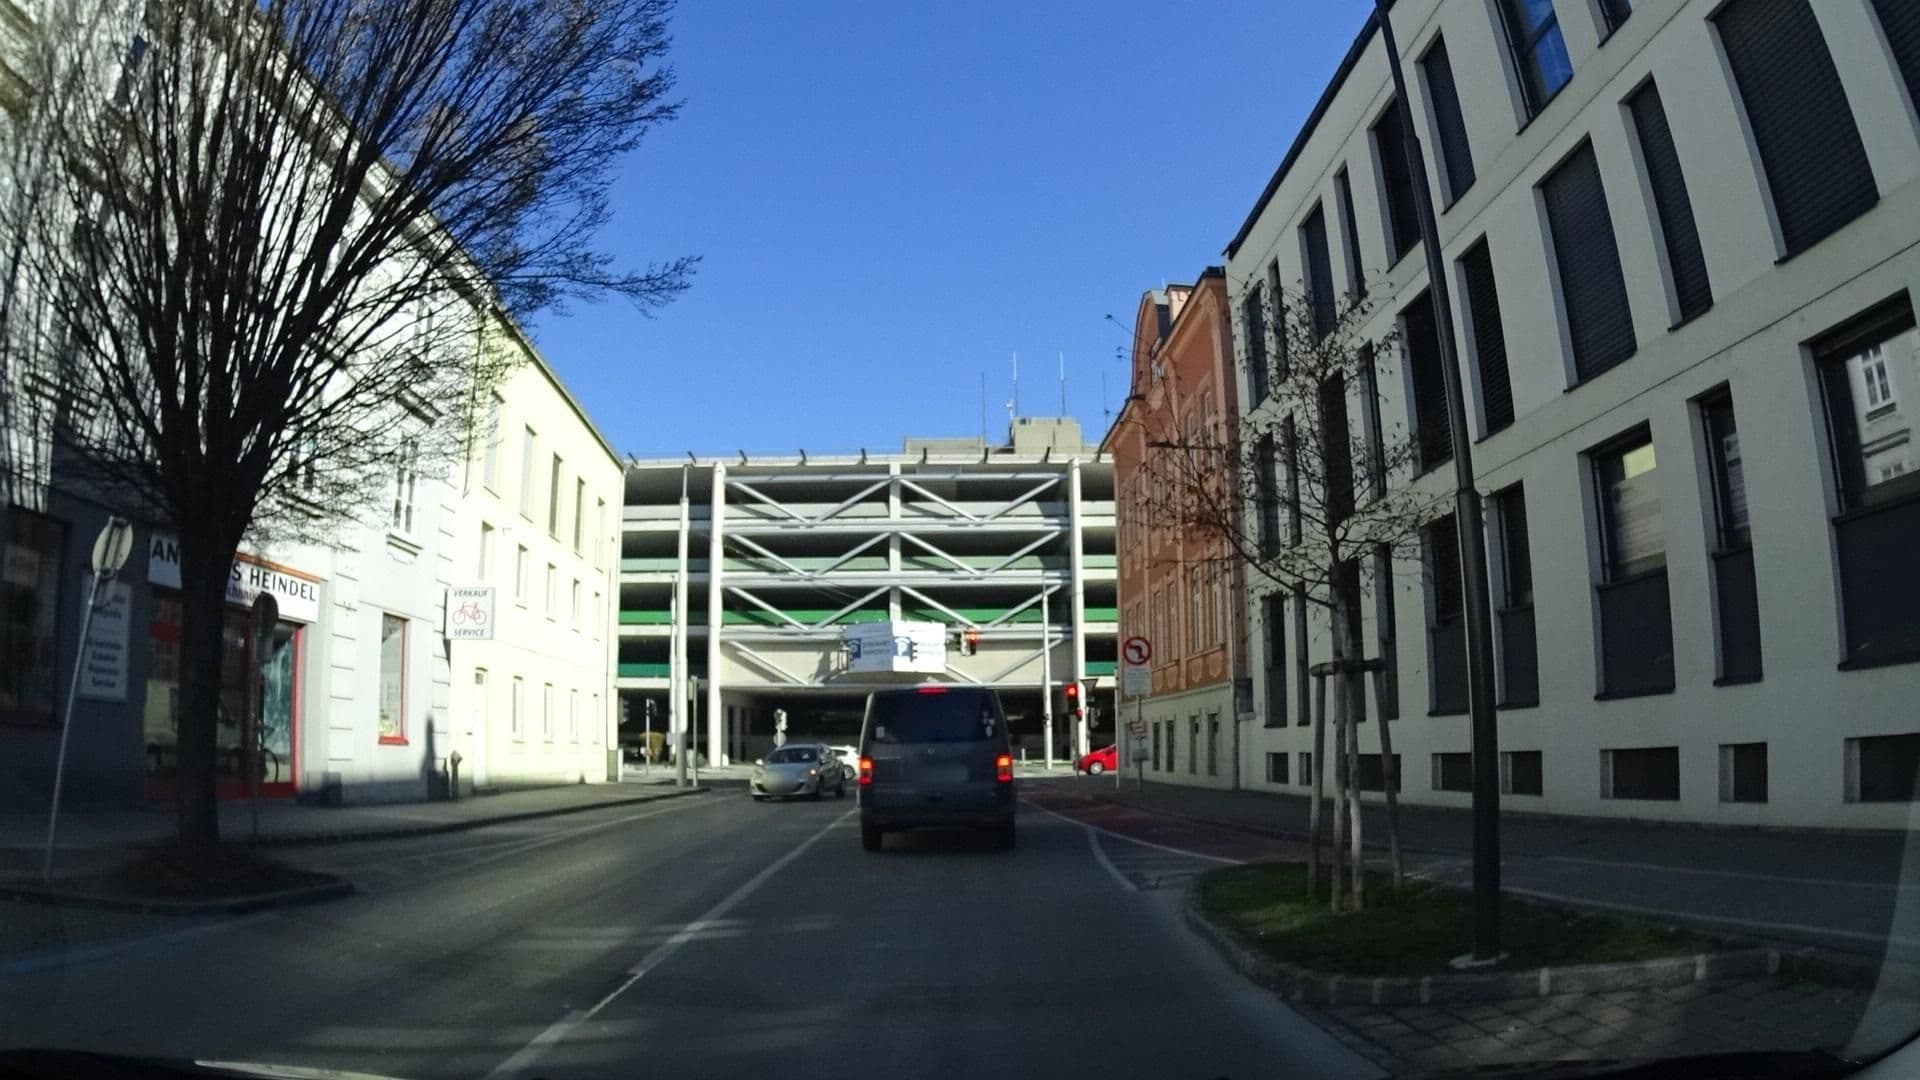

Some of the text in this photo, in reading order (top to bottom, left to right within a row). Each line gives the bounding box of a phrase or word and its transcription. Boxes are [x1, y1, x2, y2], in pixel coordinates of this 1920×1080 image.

[250, 567, 316, 602] HEINDEL
[453, 590, 488, 598] VERKAUF
[453, 629, 485, 637] SERVICE
